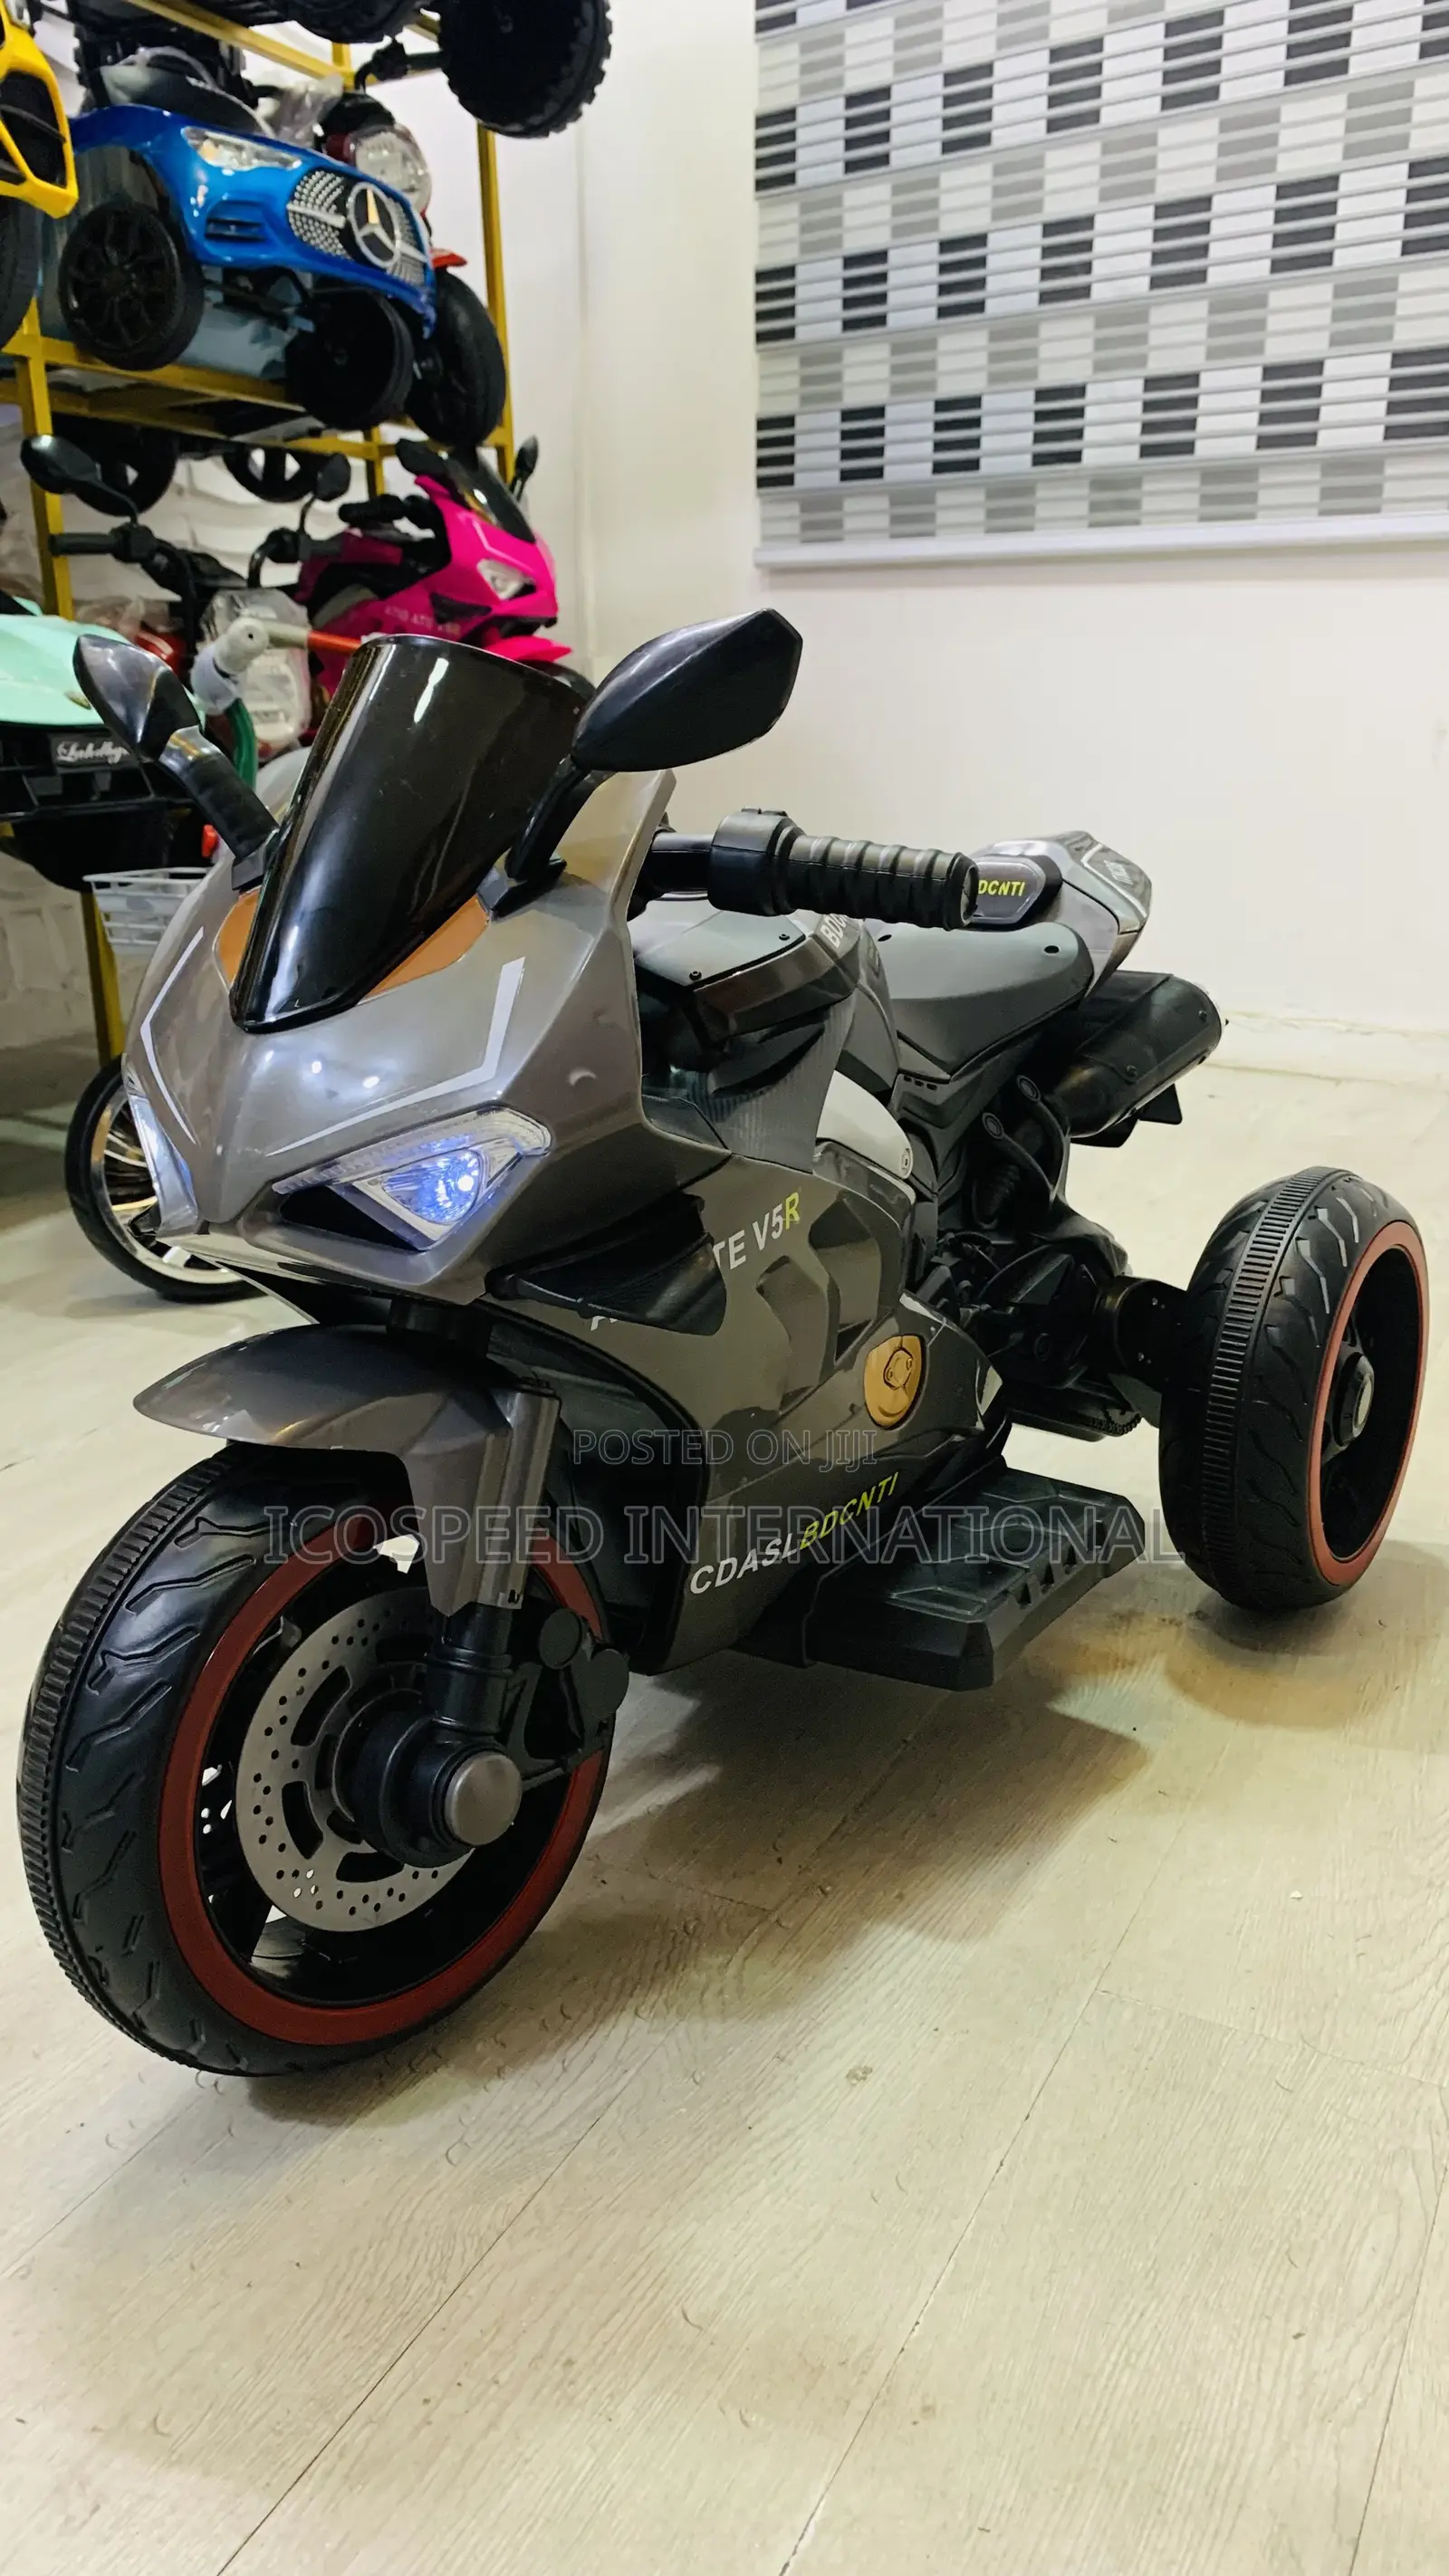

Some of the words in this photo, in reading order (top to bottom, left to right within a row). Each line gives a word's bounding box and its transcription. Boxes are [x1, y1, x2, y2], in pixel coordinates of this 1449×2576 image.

[978, 879, 1026, 897] DCNTI
[713, 1230, 747, 1270] TE
[752, 1192, 801, 1251] V5R
